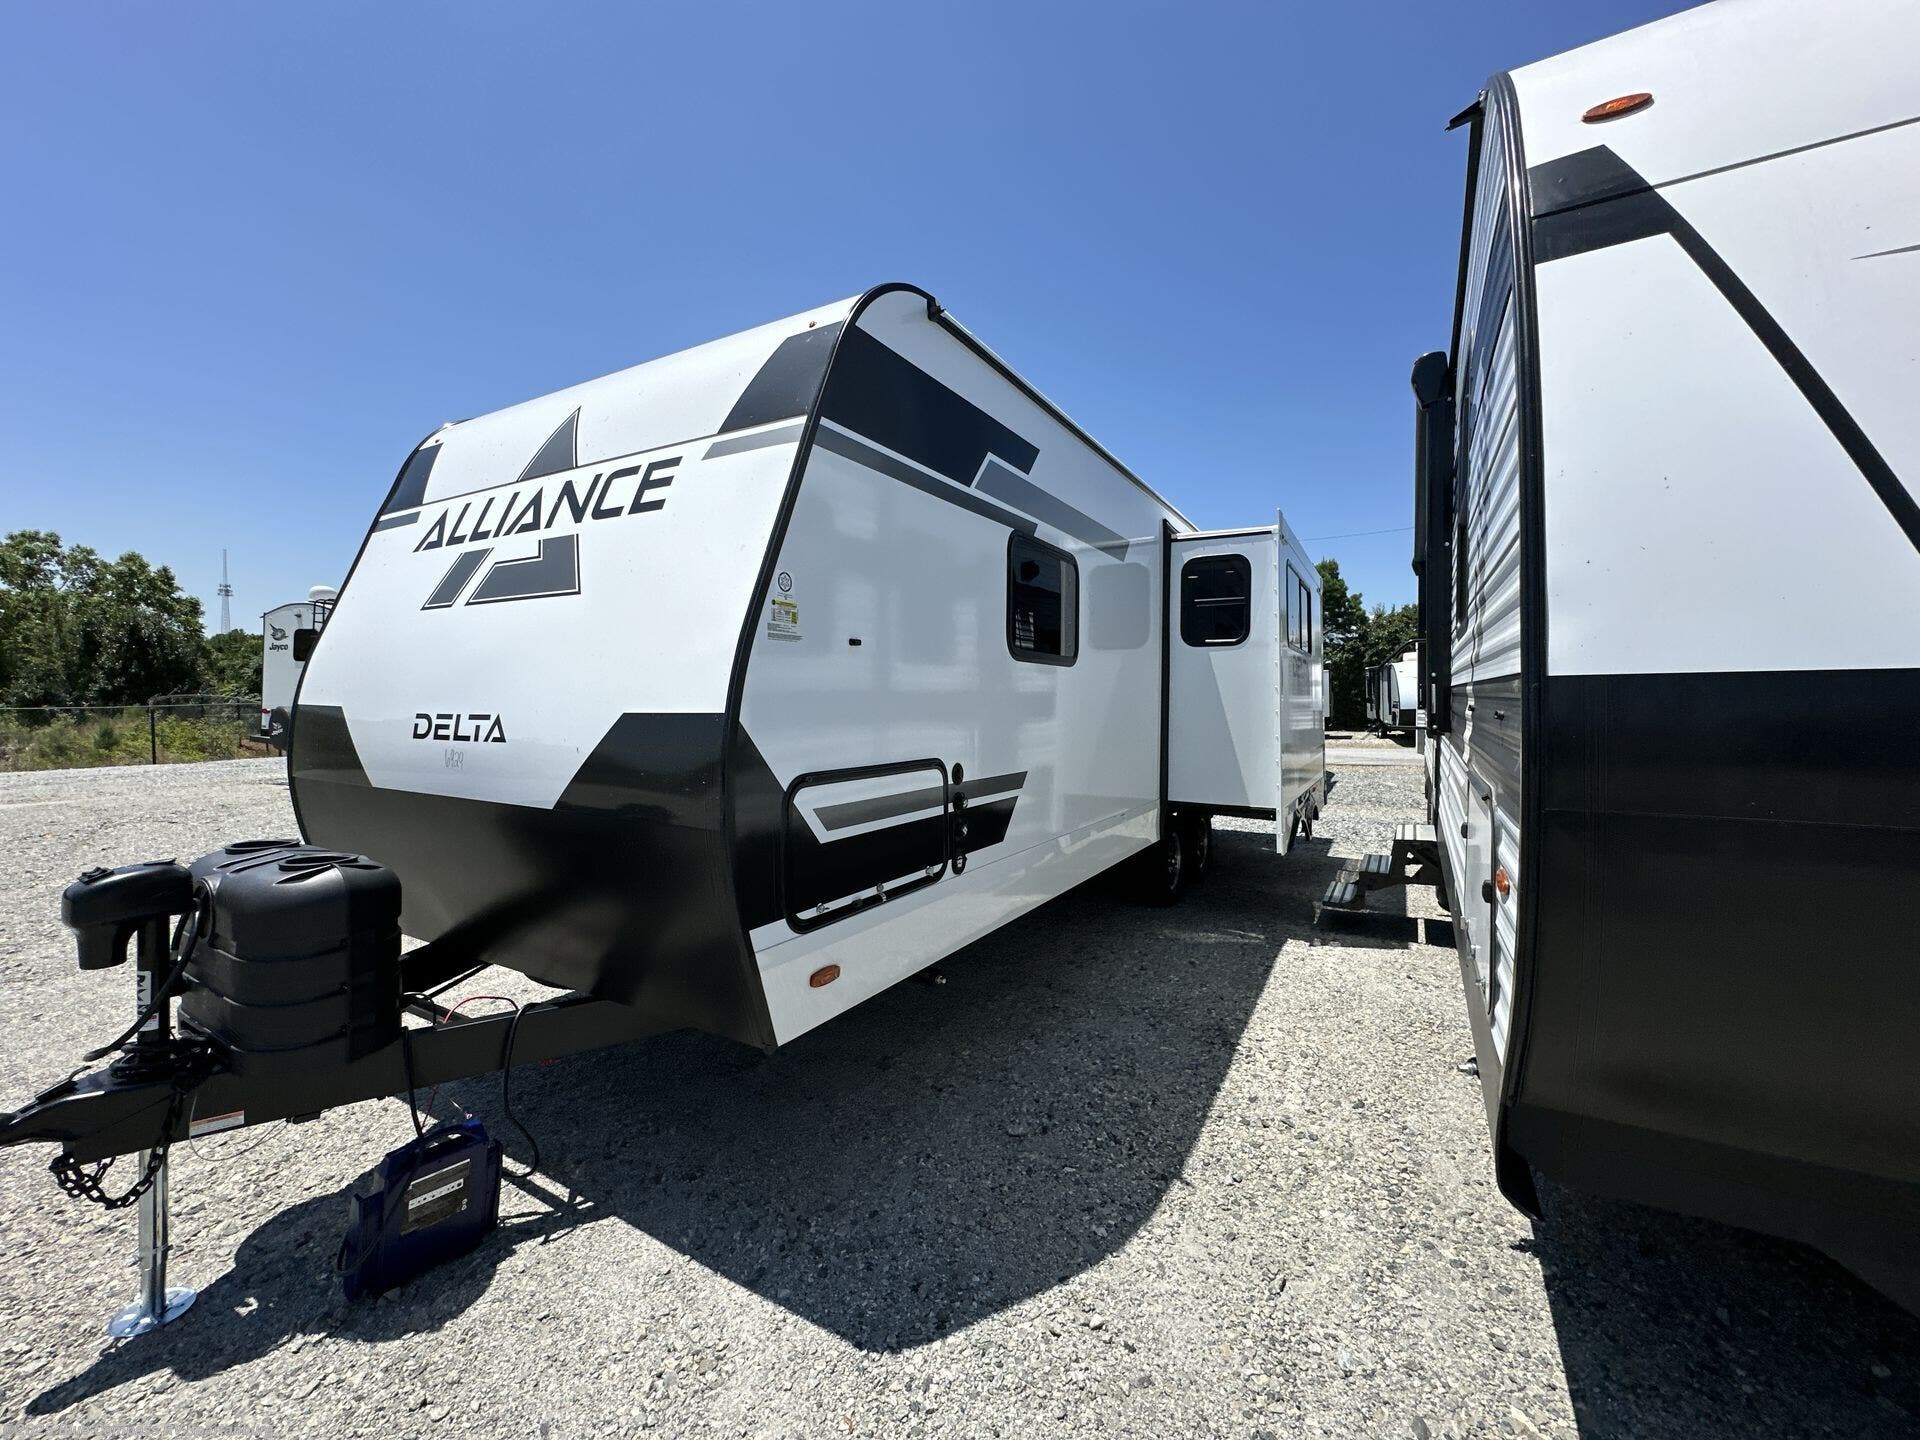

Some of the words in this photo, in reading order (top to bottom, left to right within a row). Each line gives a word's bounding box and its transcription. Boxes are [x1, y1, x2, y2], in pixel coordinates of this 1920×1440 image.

[412, 456, 683, 553] ALLIANCE
[269, 642, 289, 652] Jayco
[412, 713, 507, 743] DELTA
